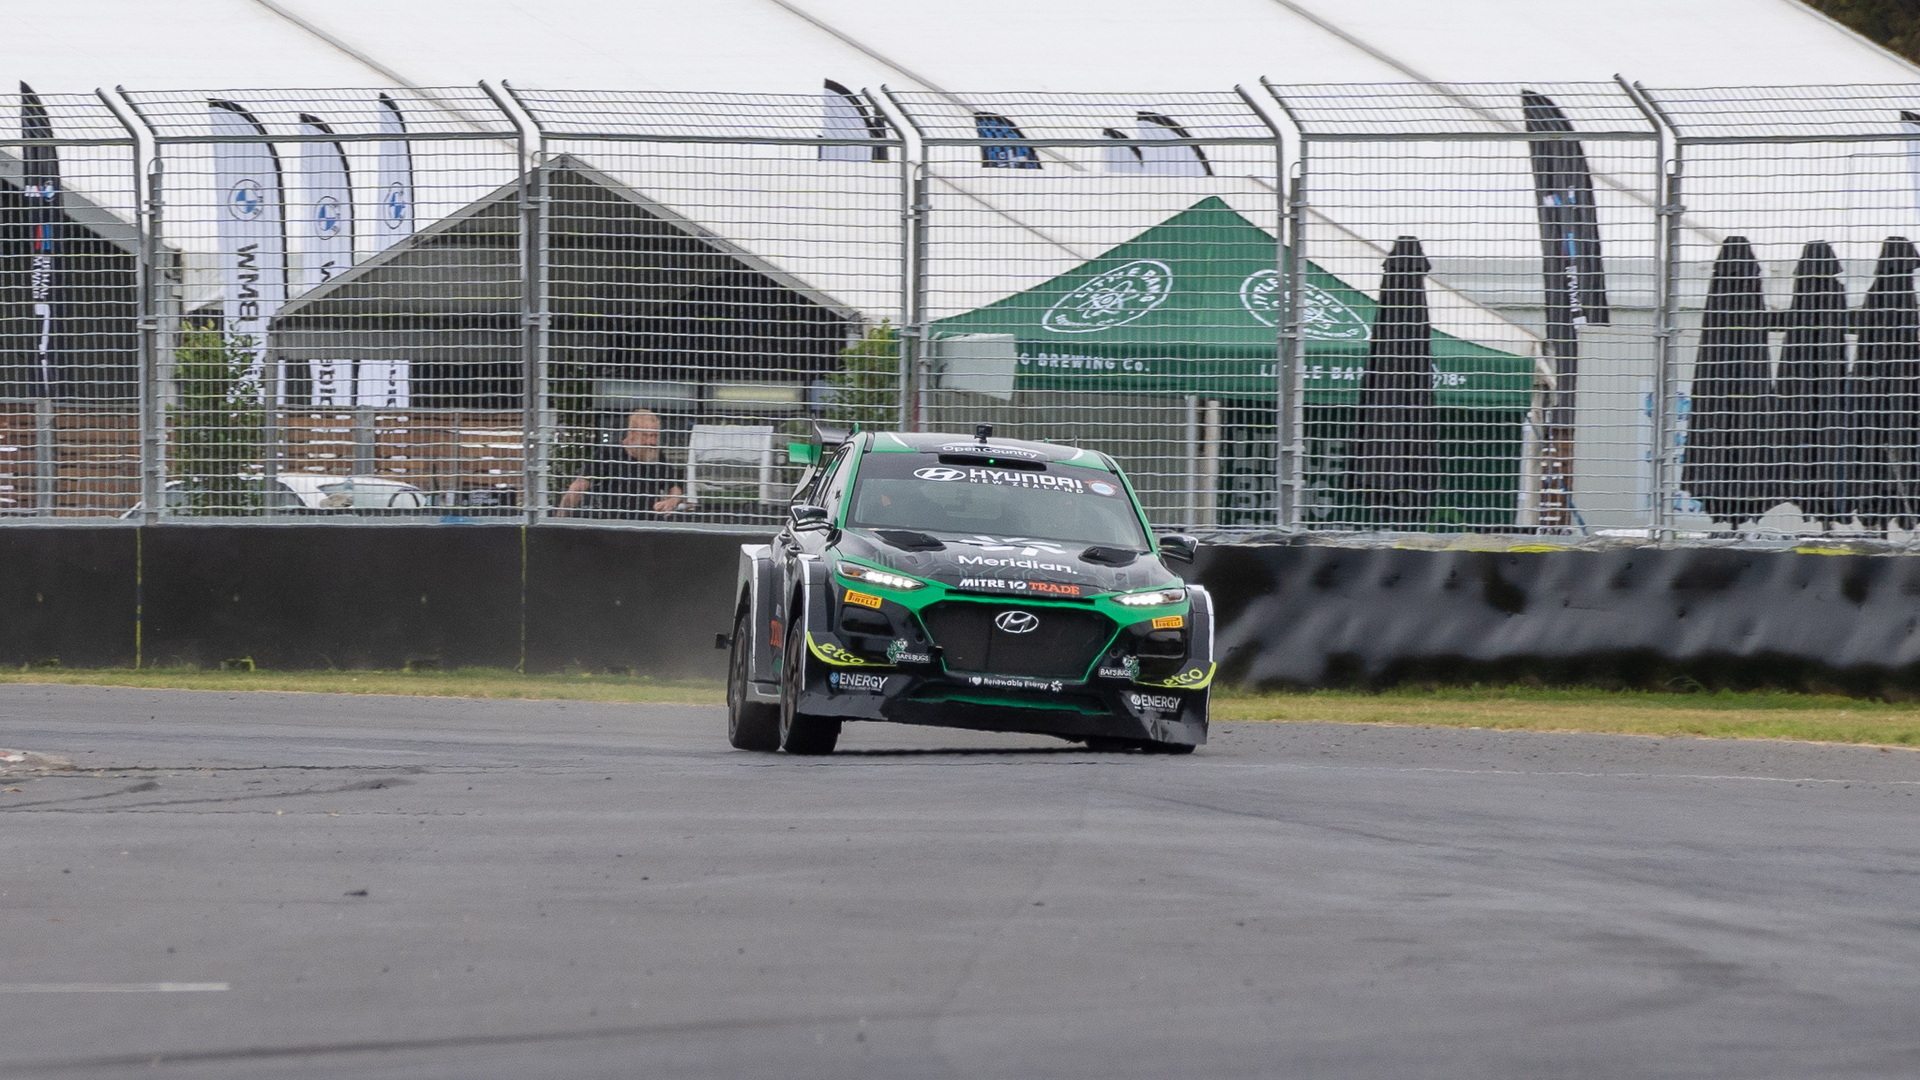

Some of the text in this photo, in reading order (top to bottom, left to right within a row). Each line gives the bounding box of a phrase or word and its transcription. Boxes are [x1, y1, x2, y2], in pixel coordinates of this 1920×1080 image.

[1038, 352, 1116, 370] BREWING
[969, 468, 1084, 489] HYUNDAI
[1012, 483, 1085, 494] ZEALAND
[957, 555, 1079, 575] Meridian.
[958, 578, 1081, 596] MITRE 10 TRADE
[848, 592, 879, 607] PIRELLI
[817, 642, 866, 665] etco
[839, 672, 889, 689] ENERGY
[983, 677, 1023, 687] Renewable
[1162, 668, 1204, 687] etco
[1141, 694, 1181, 710] ENERGY
